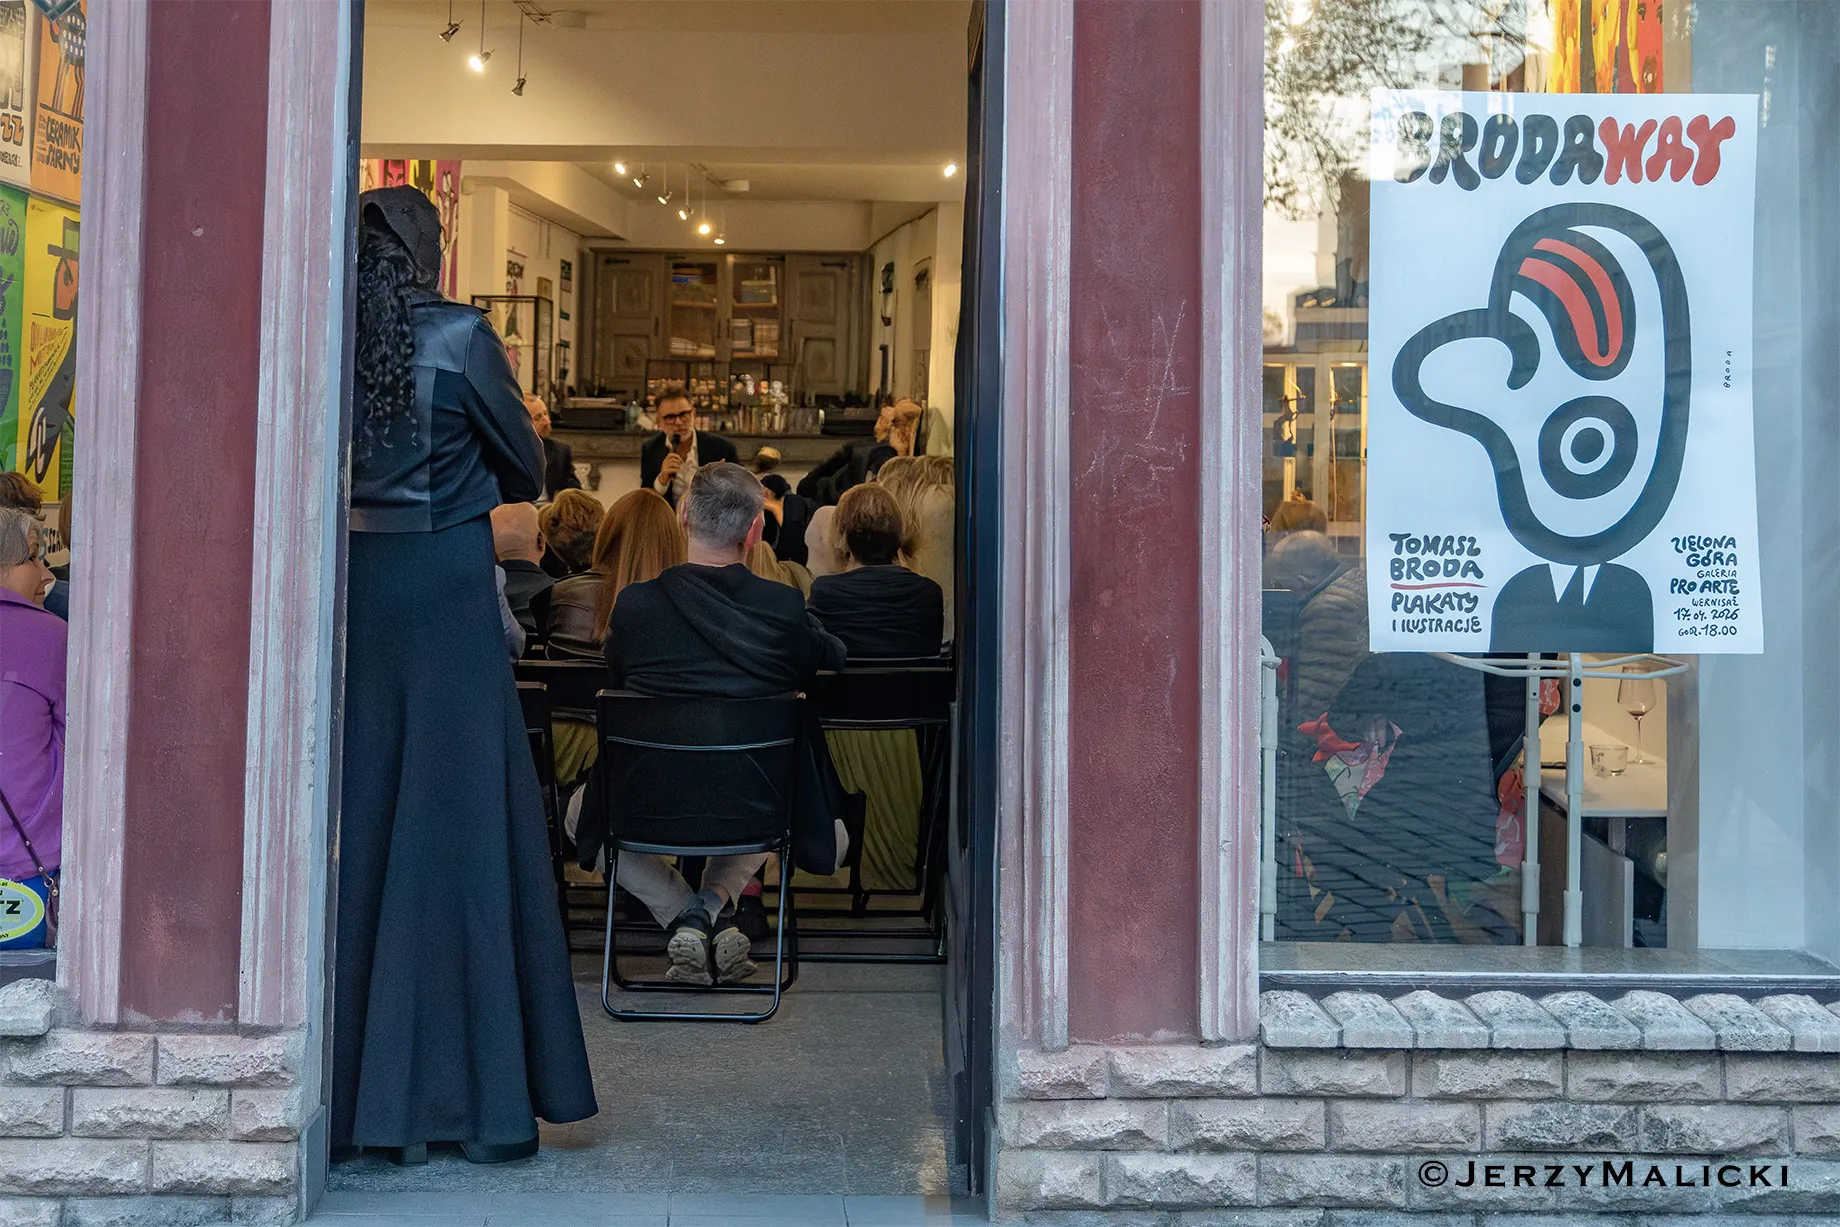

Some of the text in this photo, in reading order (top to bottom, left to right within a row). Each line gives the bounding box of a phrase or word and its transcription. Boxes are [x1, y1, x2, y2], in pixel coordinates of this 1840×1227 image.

[1393, 111, 1737, 191] BRODAWAY
[1723, 350, 1732, 388] BRODA
[1389, 533, 1481, 556] TOMASZ
[1671, 535, 1737, 553] ZIELONA
[1686, 549, 1738, 567] GÓRA
[1390, 557, 1484, 581] BRODA
[1697, 568, 1737, 578] GALERIA
[1670, 578, 1740, 595] PRO ARTE
[1391, 592, 1478, 614] PLAKATY
[1692, 596, 1739, 607] WERNISAŻ
[1392, 616, 1482, 634] I ILUSTRACJE
